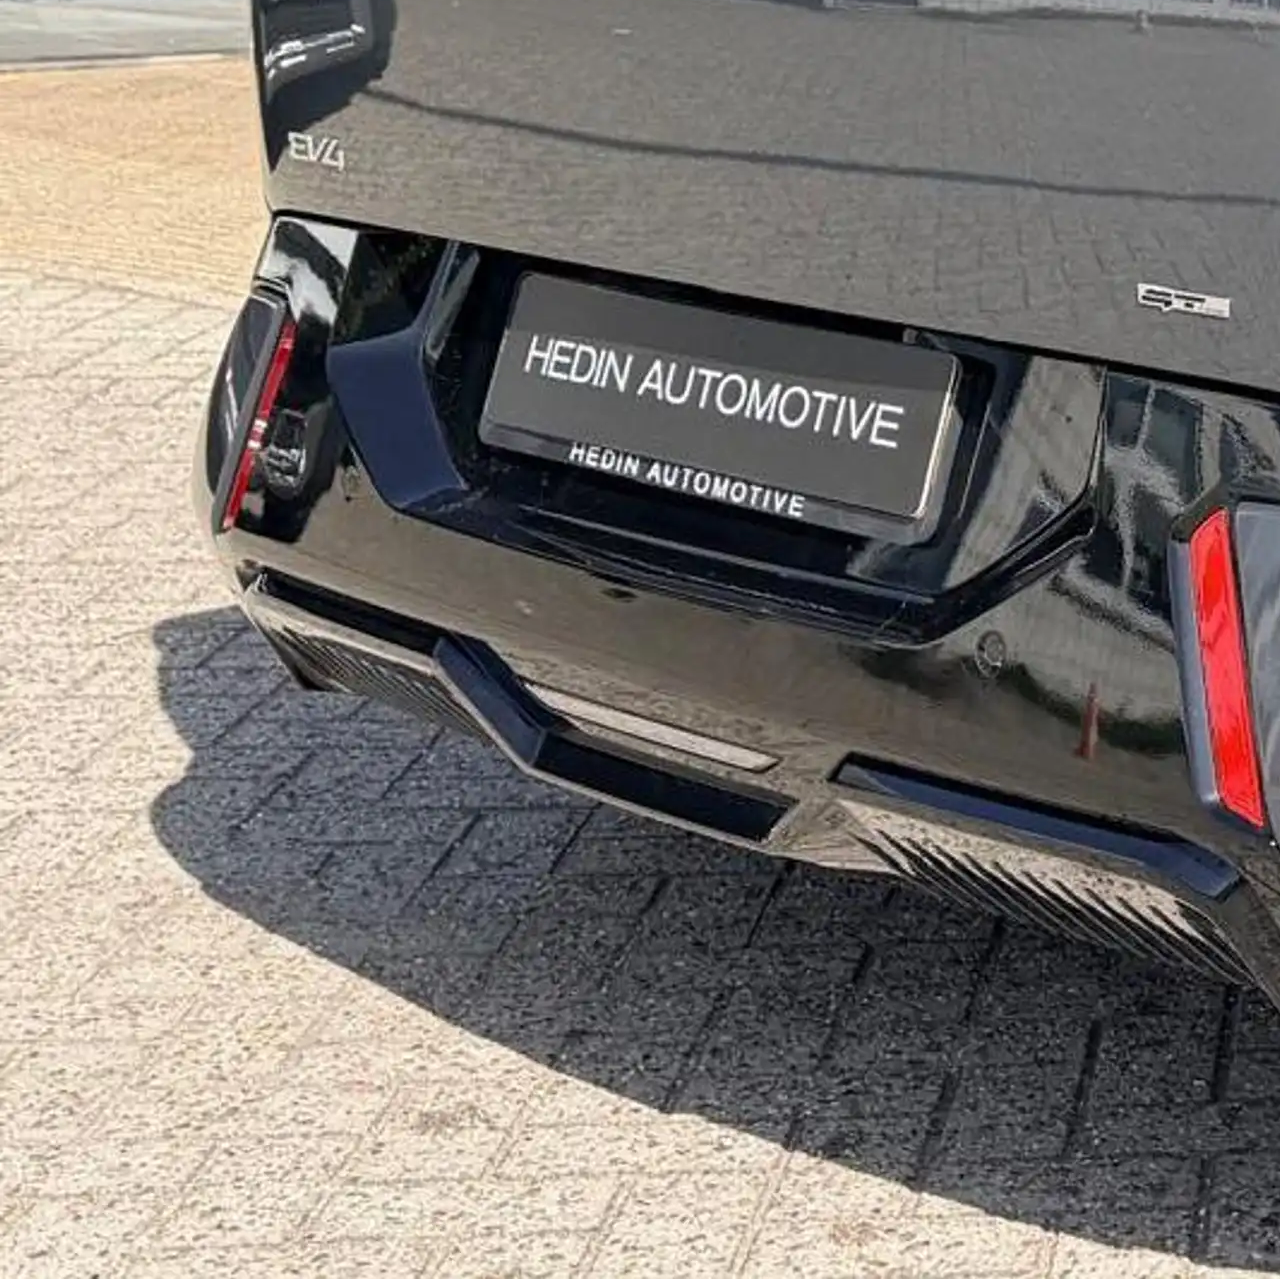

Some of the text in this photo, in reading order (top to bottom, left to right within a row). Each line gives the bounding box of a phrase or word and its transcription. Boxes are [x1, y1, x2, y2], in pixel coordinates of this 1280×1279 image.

[287, 131, 346, 172] EV4
[523, 333, 904, 449] HEDIN AUTOMOTIVE
[568, 441, 806, 518] HEDIN AUTOMOTIVE
